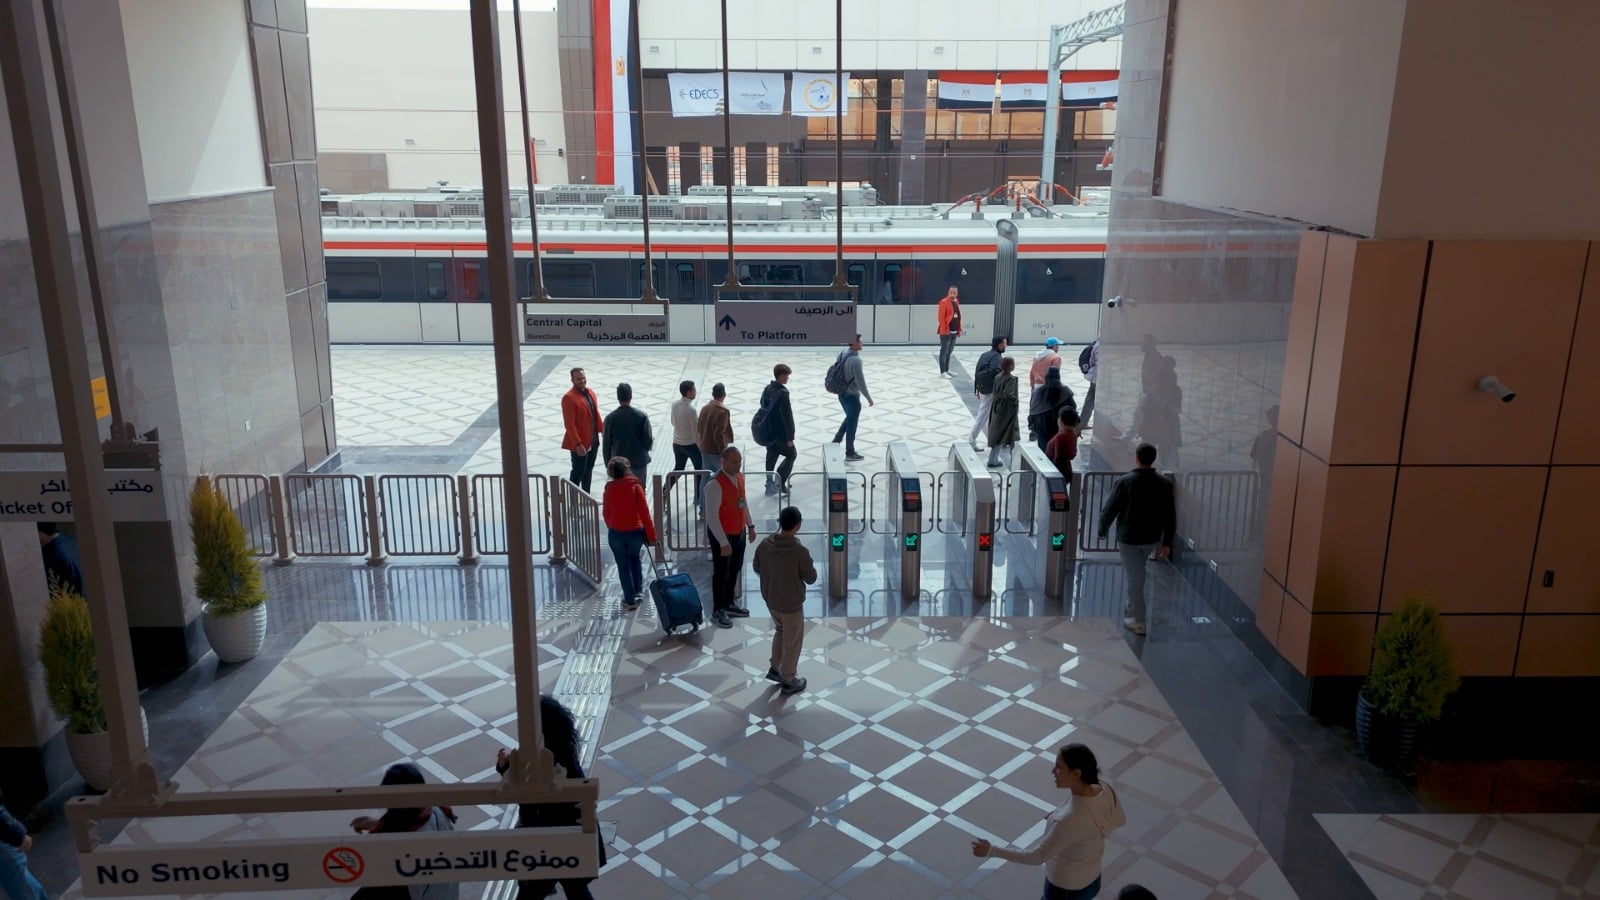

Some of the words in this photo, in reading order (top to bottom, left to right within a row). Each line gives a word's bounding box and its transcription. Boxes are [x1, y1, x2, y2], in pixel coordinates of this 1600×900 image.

[689, 88, 719, 100] EDECS
[795, 305, 833, 317] الرصيف
[527, 318, 564, 327] Central
[566, 318, 602, 330] Capital
[586, 332, 626, 342] المركزية
[627, 332, 666, 341] العاصمة
[741, 331, 754, 340] To
[758, 331, 807, 340] Platform
[107, 479, 153, 495] مكتب
[0, 501, 46, 514] icket
[395, 849, 497, 877] التدخين
[503, 849, 580, 872] ممنوع
[97, 865, 139, 884] No
[151, 859, 290, 883] Smoking
